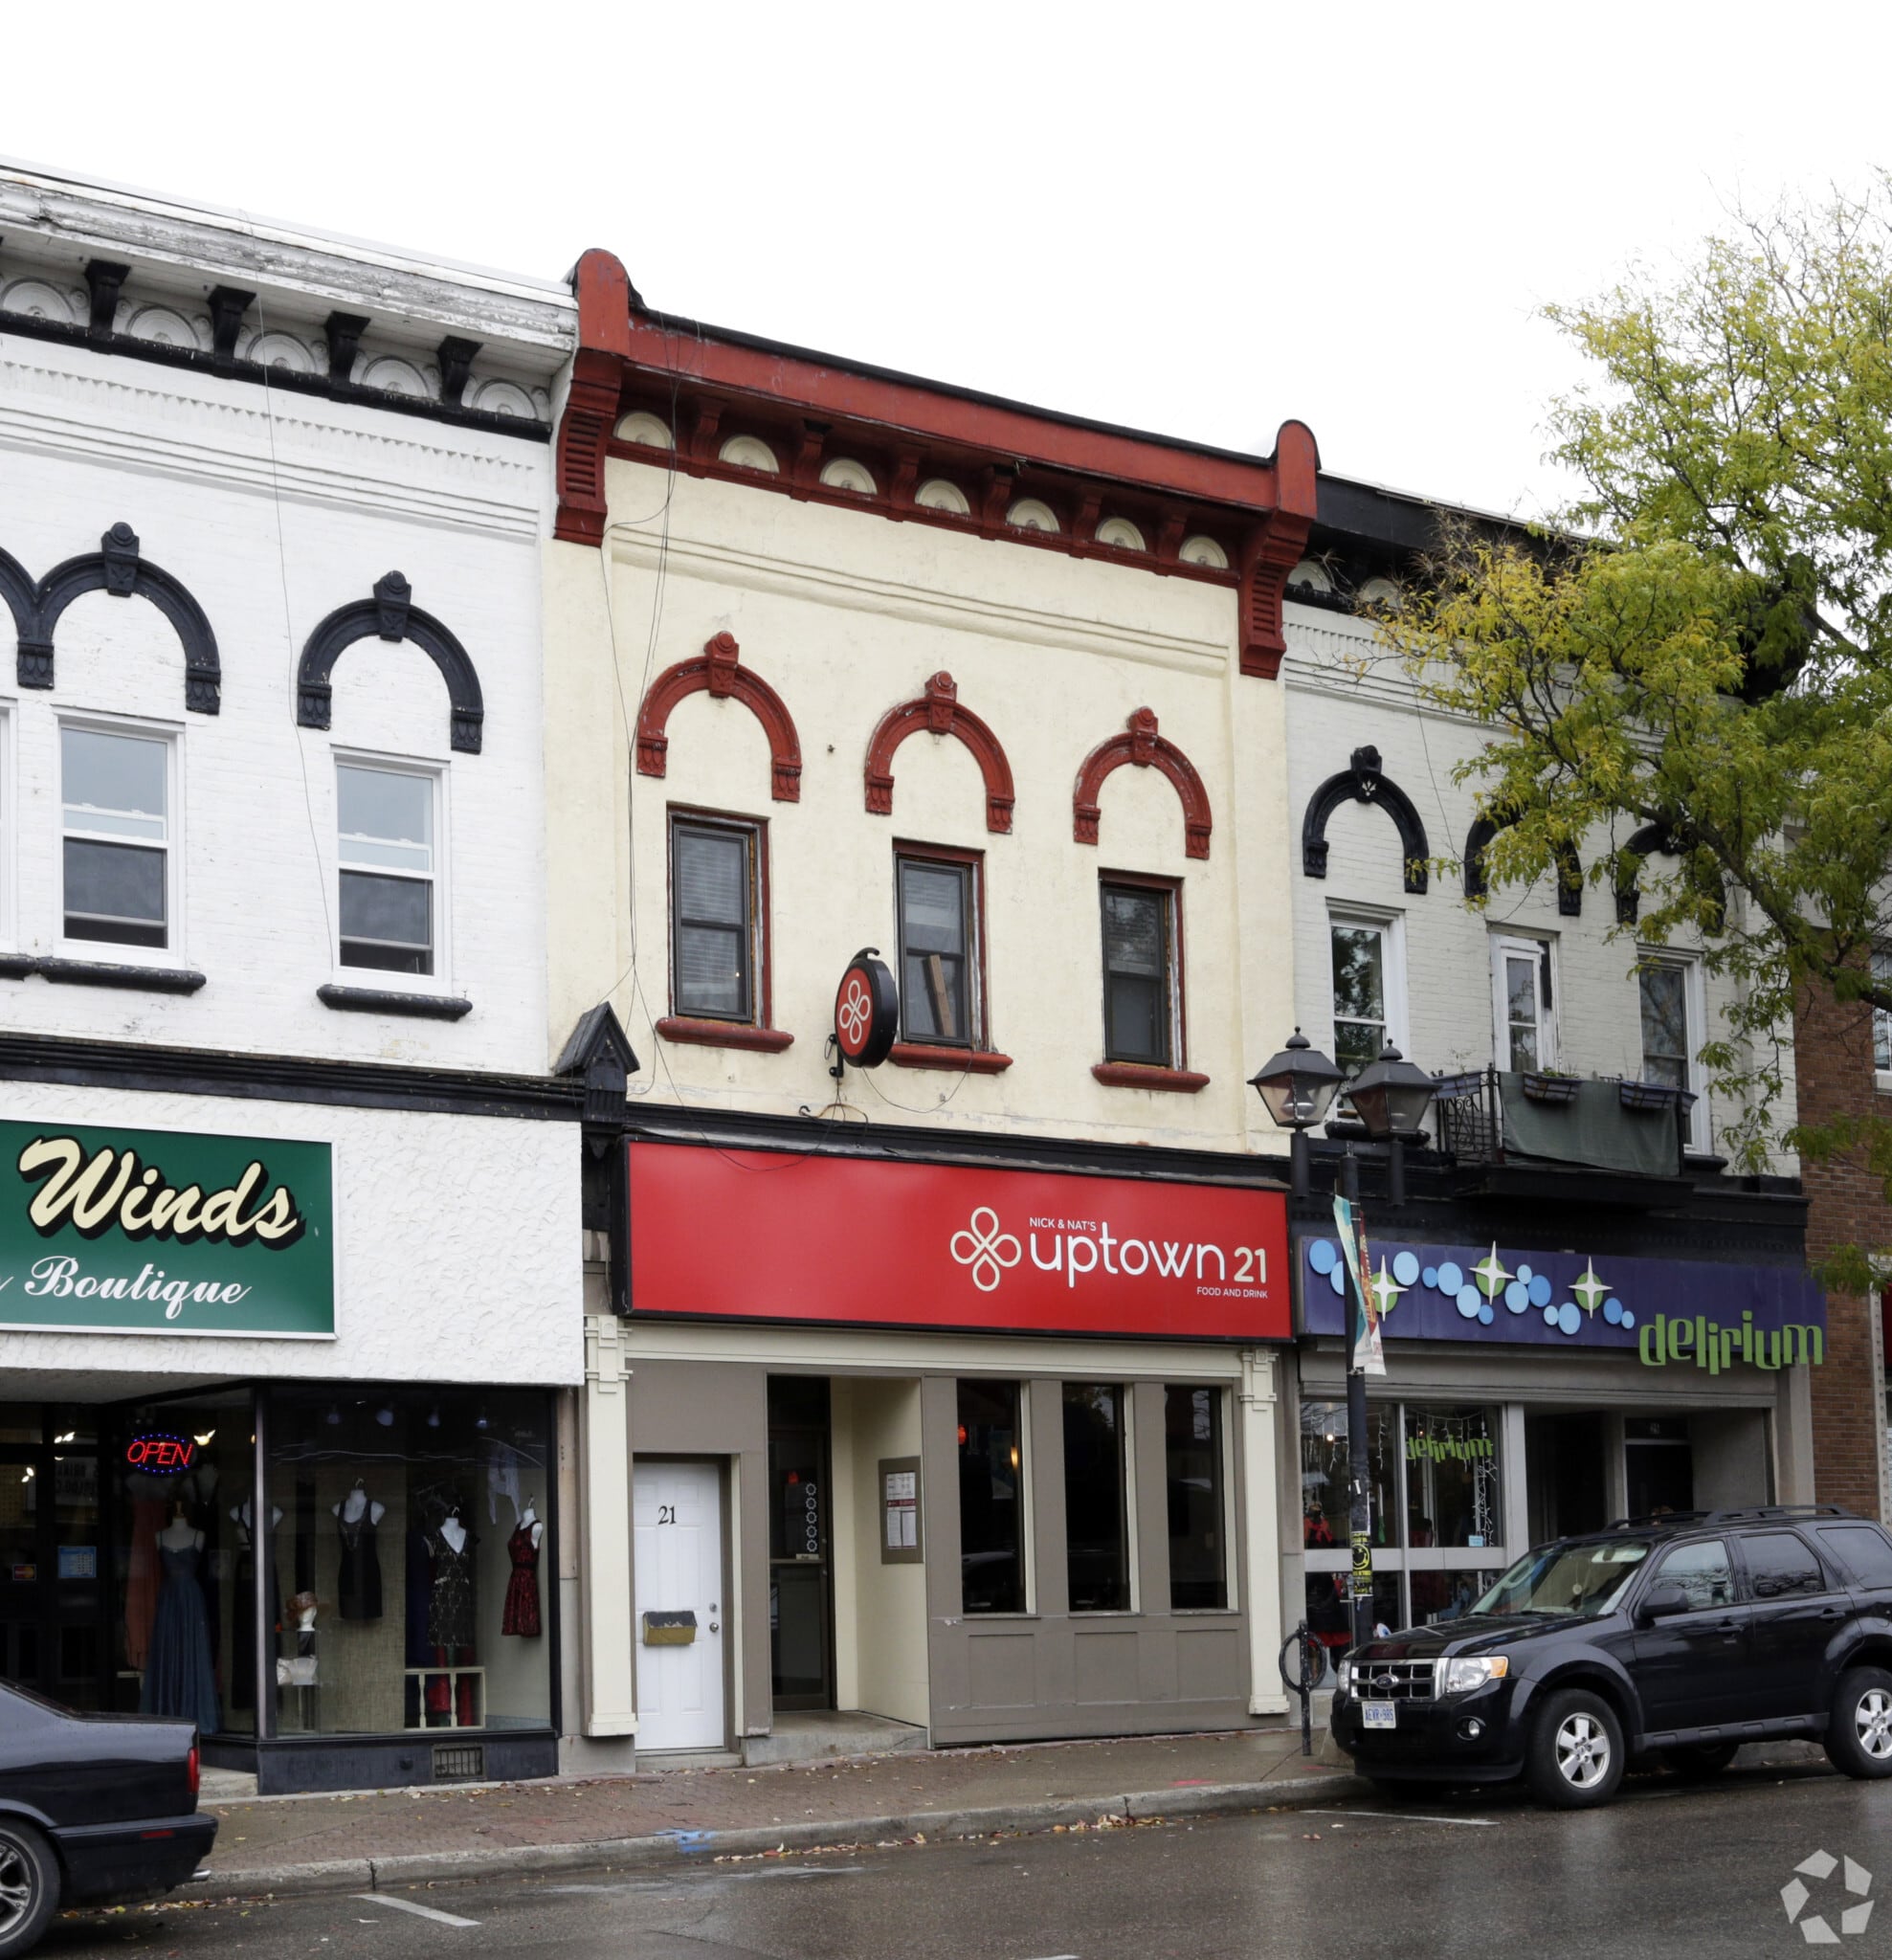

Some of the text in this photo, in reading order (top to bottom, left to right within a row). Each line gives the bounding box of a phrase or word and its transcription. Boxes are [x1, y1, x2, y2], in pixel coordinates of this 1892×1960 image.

[17, 1136, 302, 1246] Winds
[1029, 1216, 1097, 1232] NICK & NAT'S
[1030, 1221, 1267, 1288] uptown 21
[24, 1255, 253, 1320] Boutique
[1196, 1286, 1268, 1299] FOOD AND DRINK
[1639, 1310, 1823, 1375] delirium
[127, 1441, 193, 1465] OPEN
[1406, 1435, 1493, 1463] delirium
[657, 1504, 677, 1526] 21
